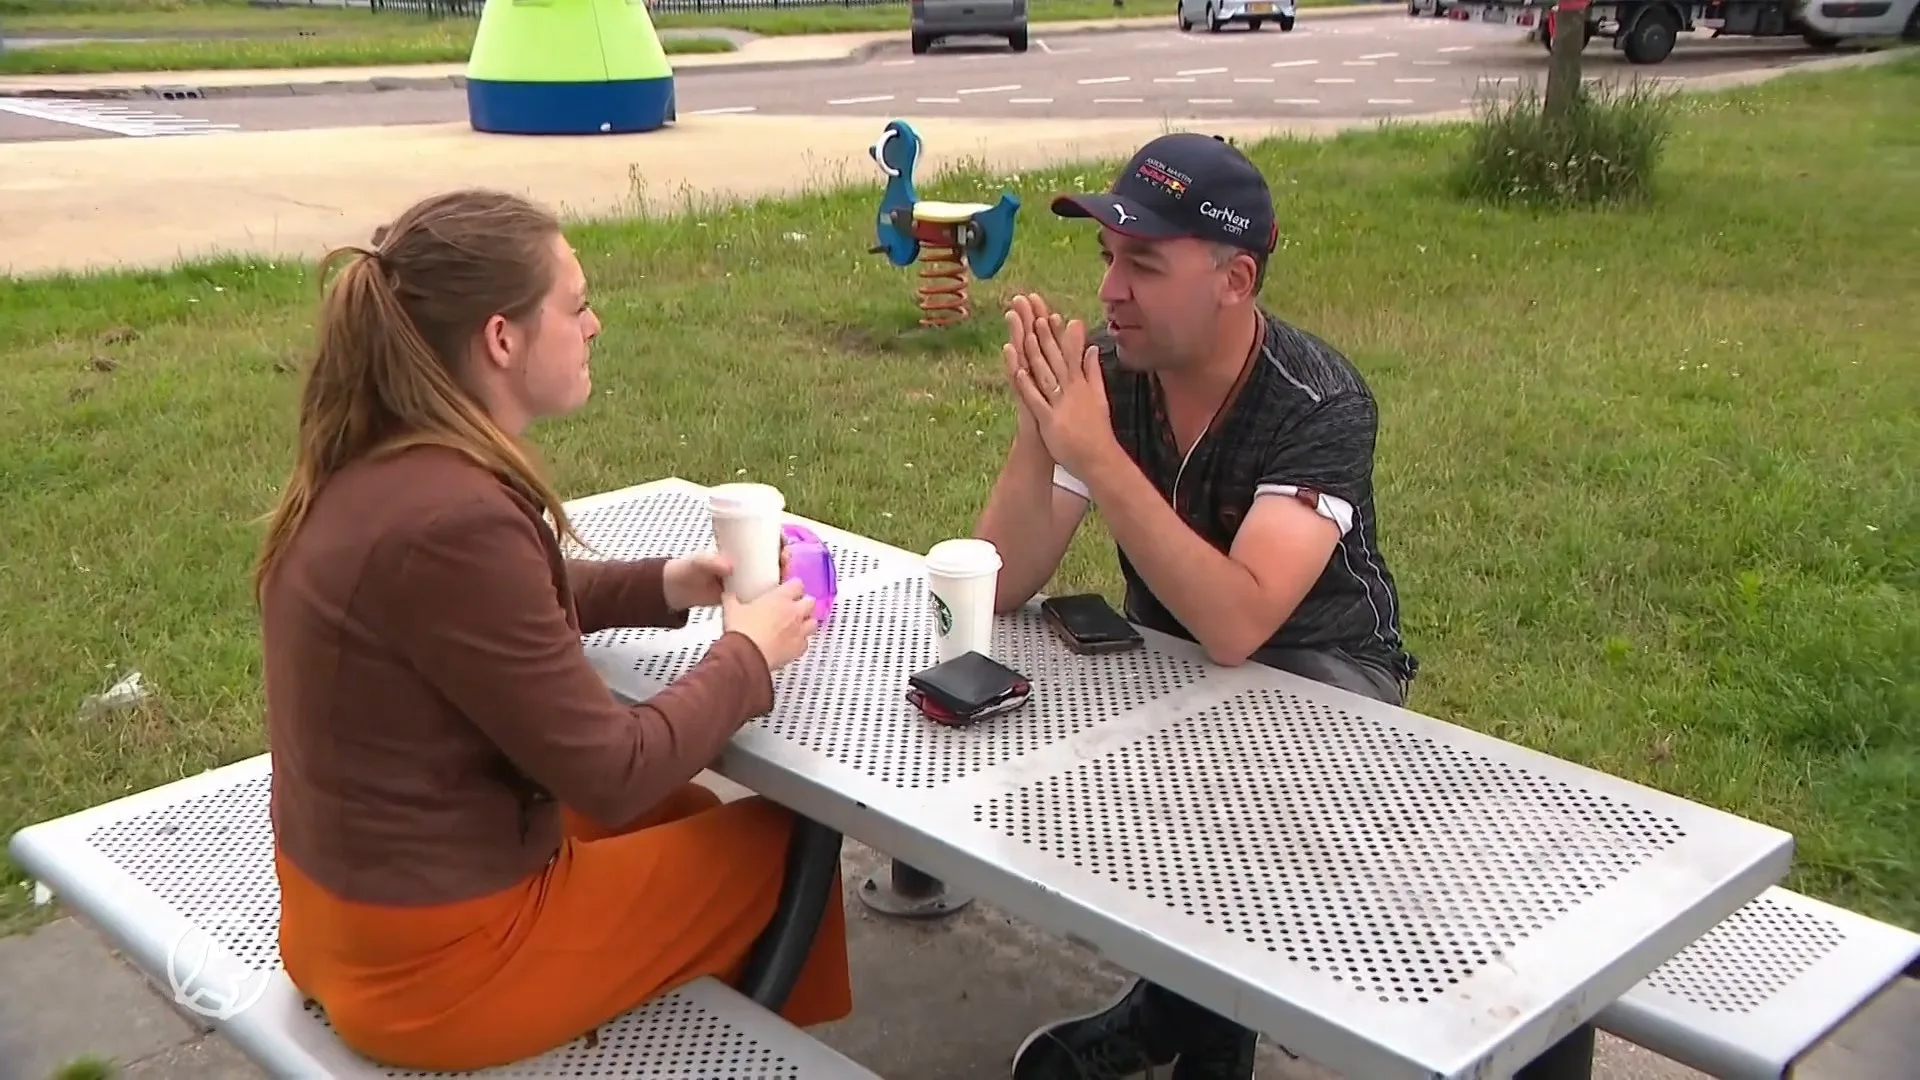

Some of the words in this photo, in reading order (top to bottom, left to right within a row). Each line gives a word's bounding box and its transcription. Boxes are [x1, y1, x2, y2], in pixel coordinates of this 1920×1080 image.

[1135, 173, 1182, 200] RACING
[1166, 167, 1193, 184] MARTIN
[1200, 201, 1251, 230] CarNext
